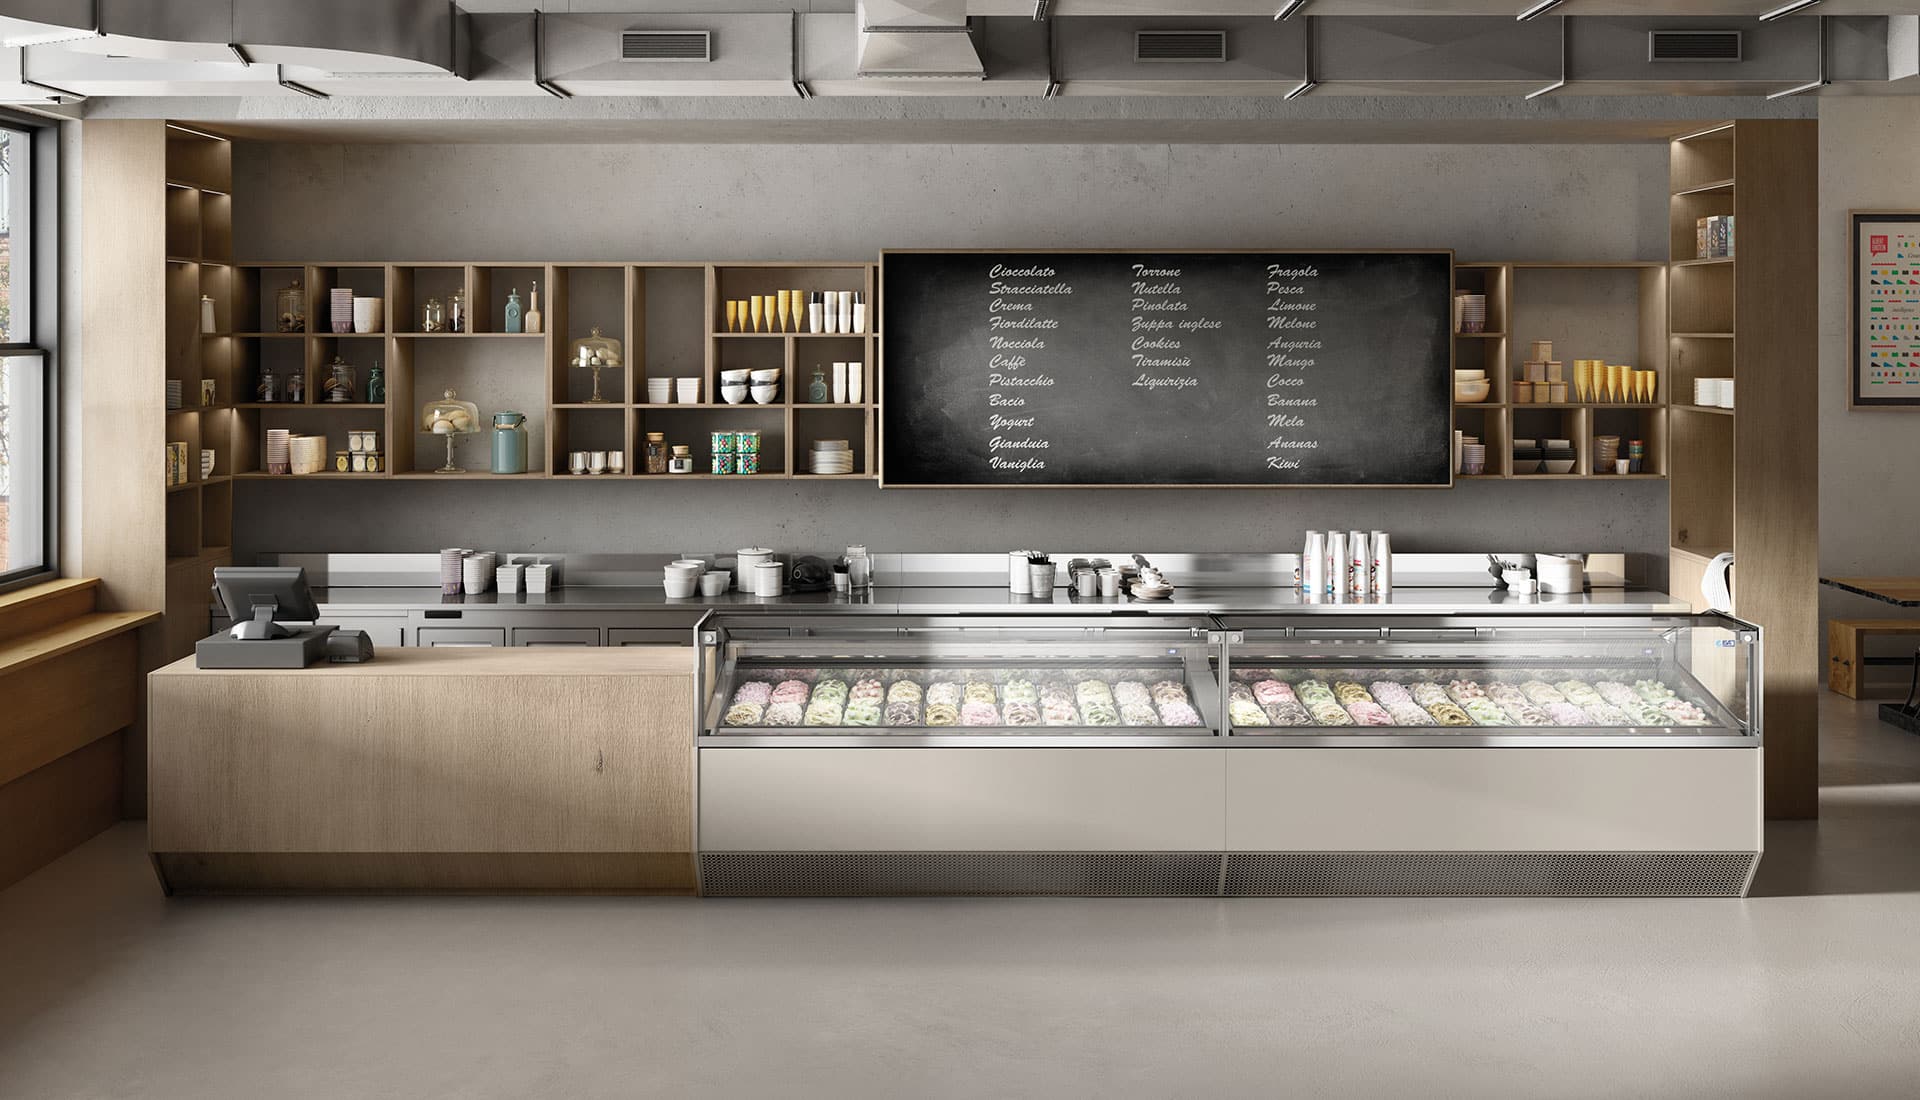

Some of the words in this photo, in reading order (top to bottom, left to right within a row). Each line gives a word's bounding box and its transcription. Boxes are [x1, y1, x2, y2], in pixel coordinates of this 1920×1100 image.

[989, 264, 1055, 278] Cioccolato
[1132, 264, 1181, 277] Torrone
[1267, 264, 1318, 280] Fragola
[989, 282, 1072, 294] Stracciatella
[1132, 282, 1181, 294] Nutella
[1267, 282, 1304, 294] Pesca
[989, 298, 1032, 312] Crema
[1132, 298, 1188, 311] Pinolata
[1268, 298, 1316, 311] Limone
[989, 316, 1058, 330] Fiordilatte
[1132, 316, 1173, 331] Zuppa
[1179, 318, 1222, 332] inglese
[1267, 316, 1316, 328] Melone
[990, 336, 1045, 349] Nocciola
[1132, 336, 1180, 350] Cookies
[1267, 337, 1321, 352] Anguria
[989, 354, 1025, 370] Caffè
[1132, 354, 1191, 366] Tiramisù
[1267, 354, 1314, 370] Mango
[989, 374, 1054, 386] Pistacchio
[1132, 374, 1198, 390] Liquirizia
[1267, 374, 1304, 388] Cocco
[989, 394, 1025, 406] Bacio
[1268, 394, 1317, 406] Banana
[990, 414, 1034, 430] Yogurt
[1268, 414, 1304, 427] Mela
[989, 436, 1049, 451] Gianduia
[1267, 436, 1318, 448] Ananas
[989, 457, 1045, 472] Vaniglia
[1267, 457, 1300, 469] Kiwi
